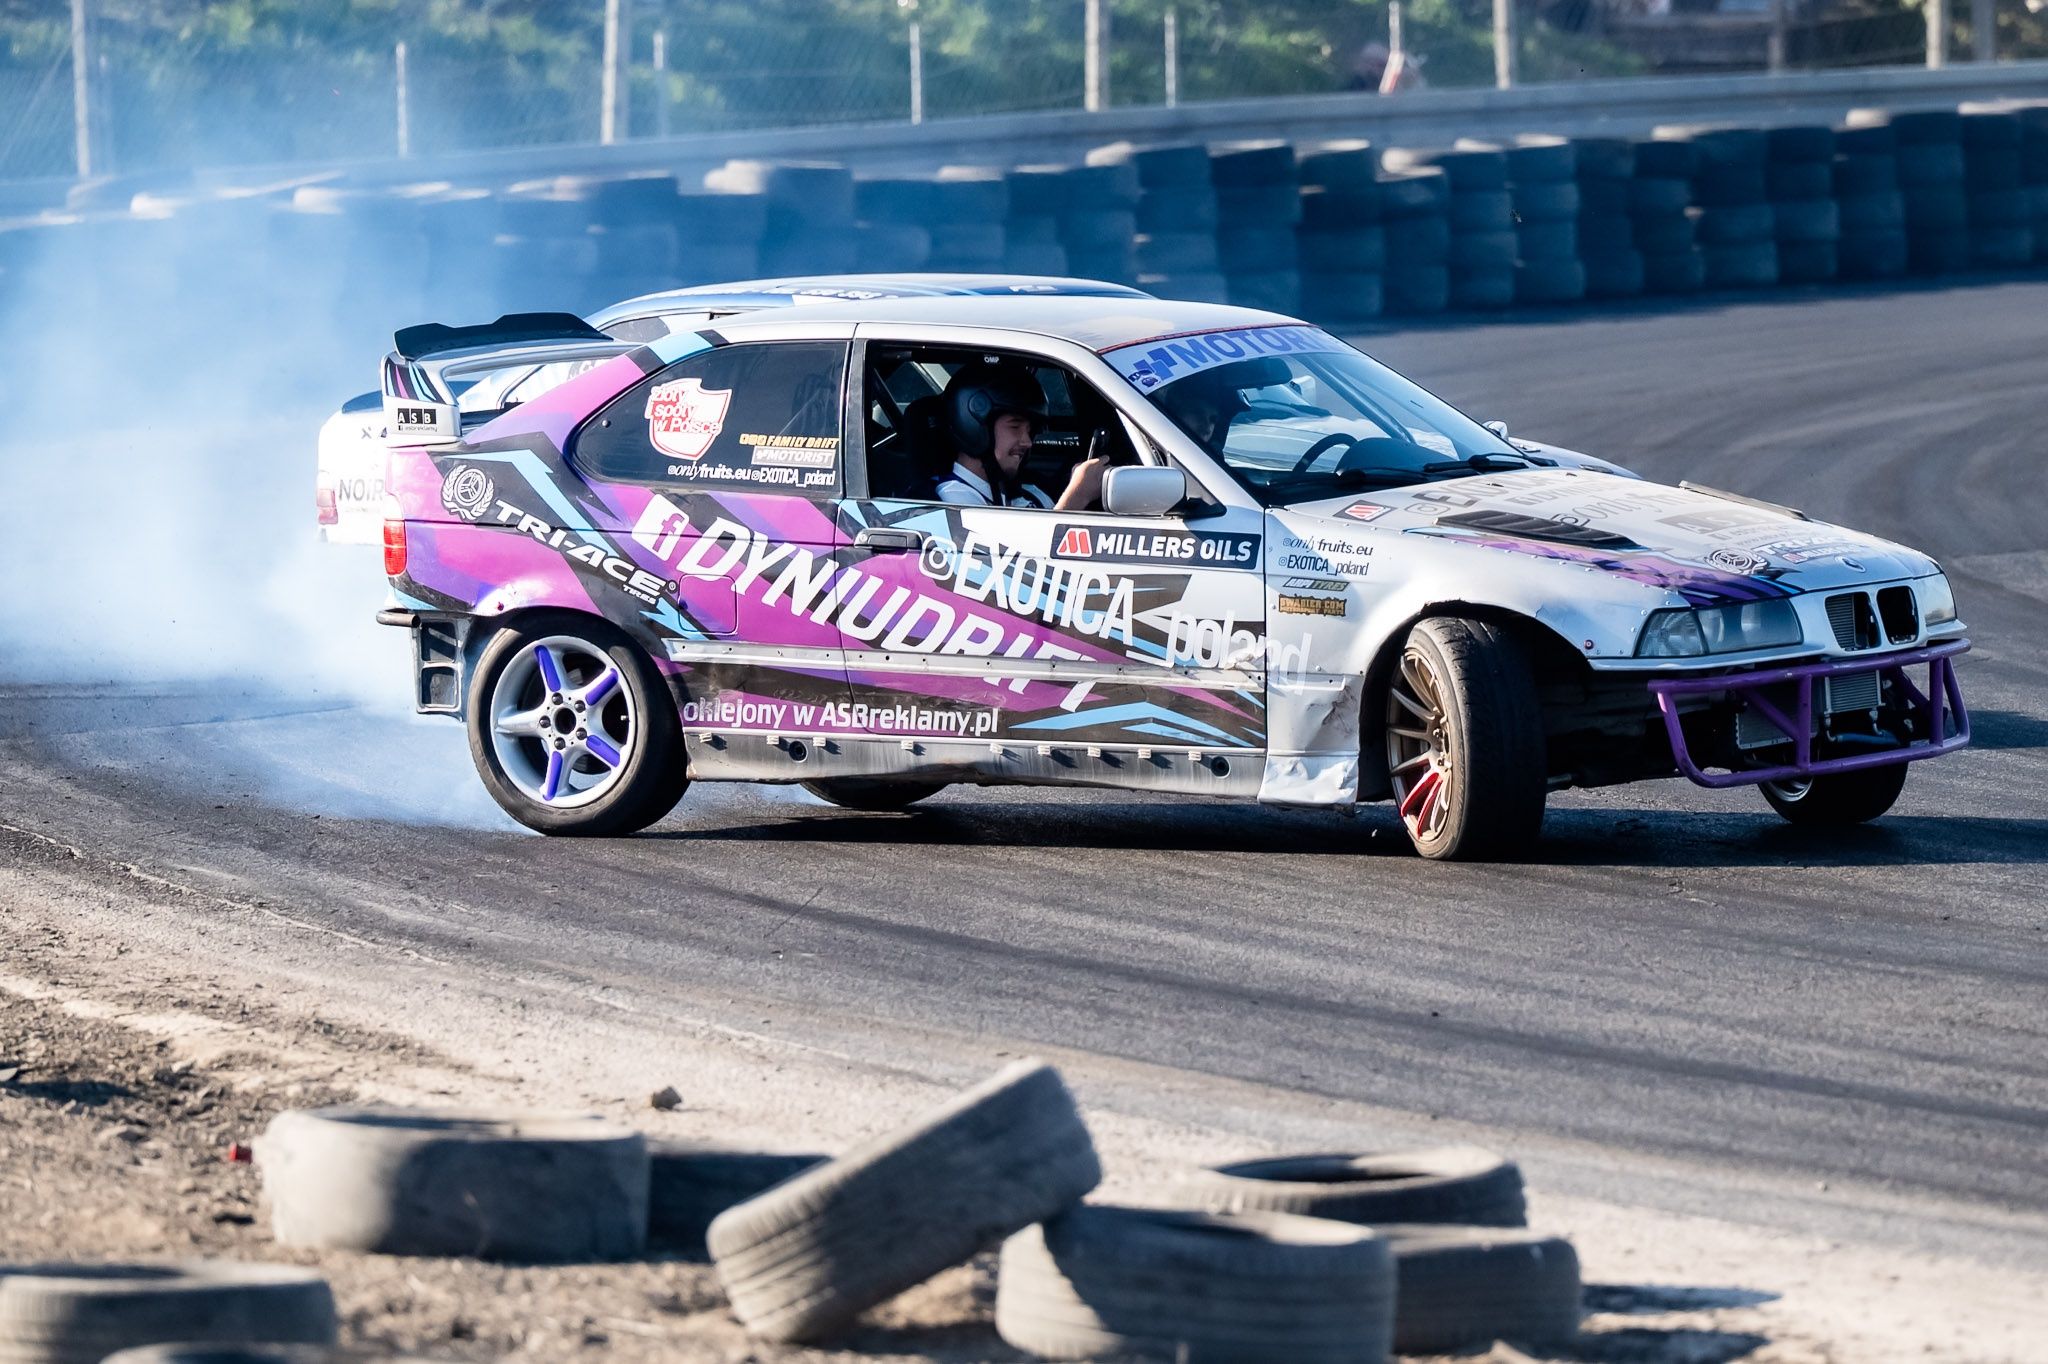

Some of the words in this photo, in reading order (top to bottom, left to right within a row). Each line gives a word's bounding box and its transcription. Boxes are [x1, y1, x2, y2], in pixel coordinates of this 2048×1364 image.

[766, 436, 806, 448] FAMILY
[805, 437, 840, 449] DRIFT
[767, 450, 834, 464] MOTORIST
[760, 467, 836, 487] EXOTICA_poland
[495, 500, 667, 597] TRI-ACE
[1095, 532, 1195, 559] MILLERS
[1199, 537, 1253, 563] OILS
[1287, 555, 1369, 577] EXOTICA_poland
[623, 584, 658, 605] TIRES
[1311, 580, 1348, 592] TYRES
[683, 698, 788, 729] oklejony
[793, 703, 812, 726] w
[819, 702, 999, 737] ASBreklamy.pl
